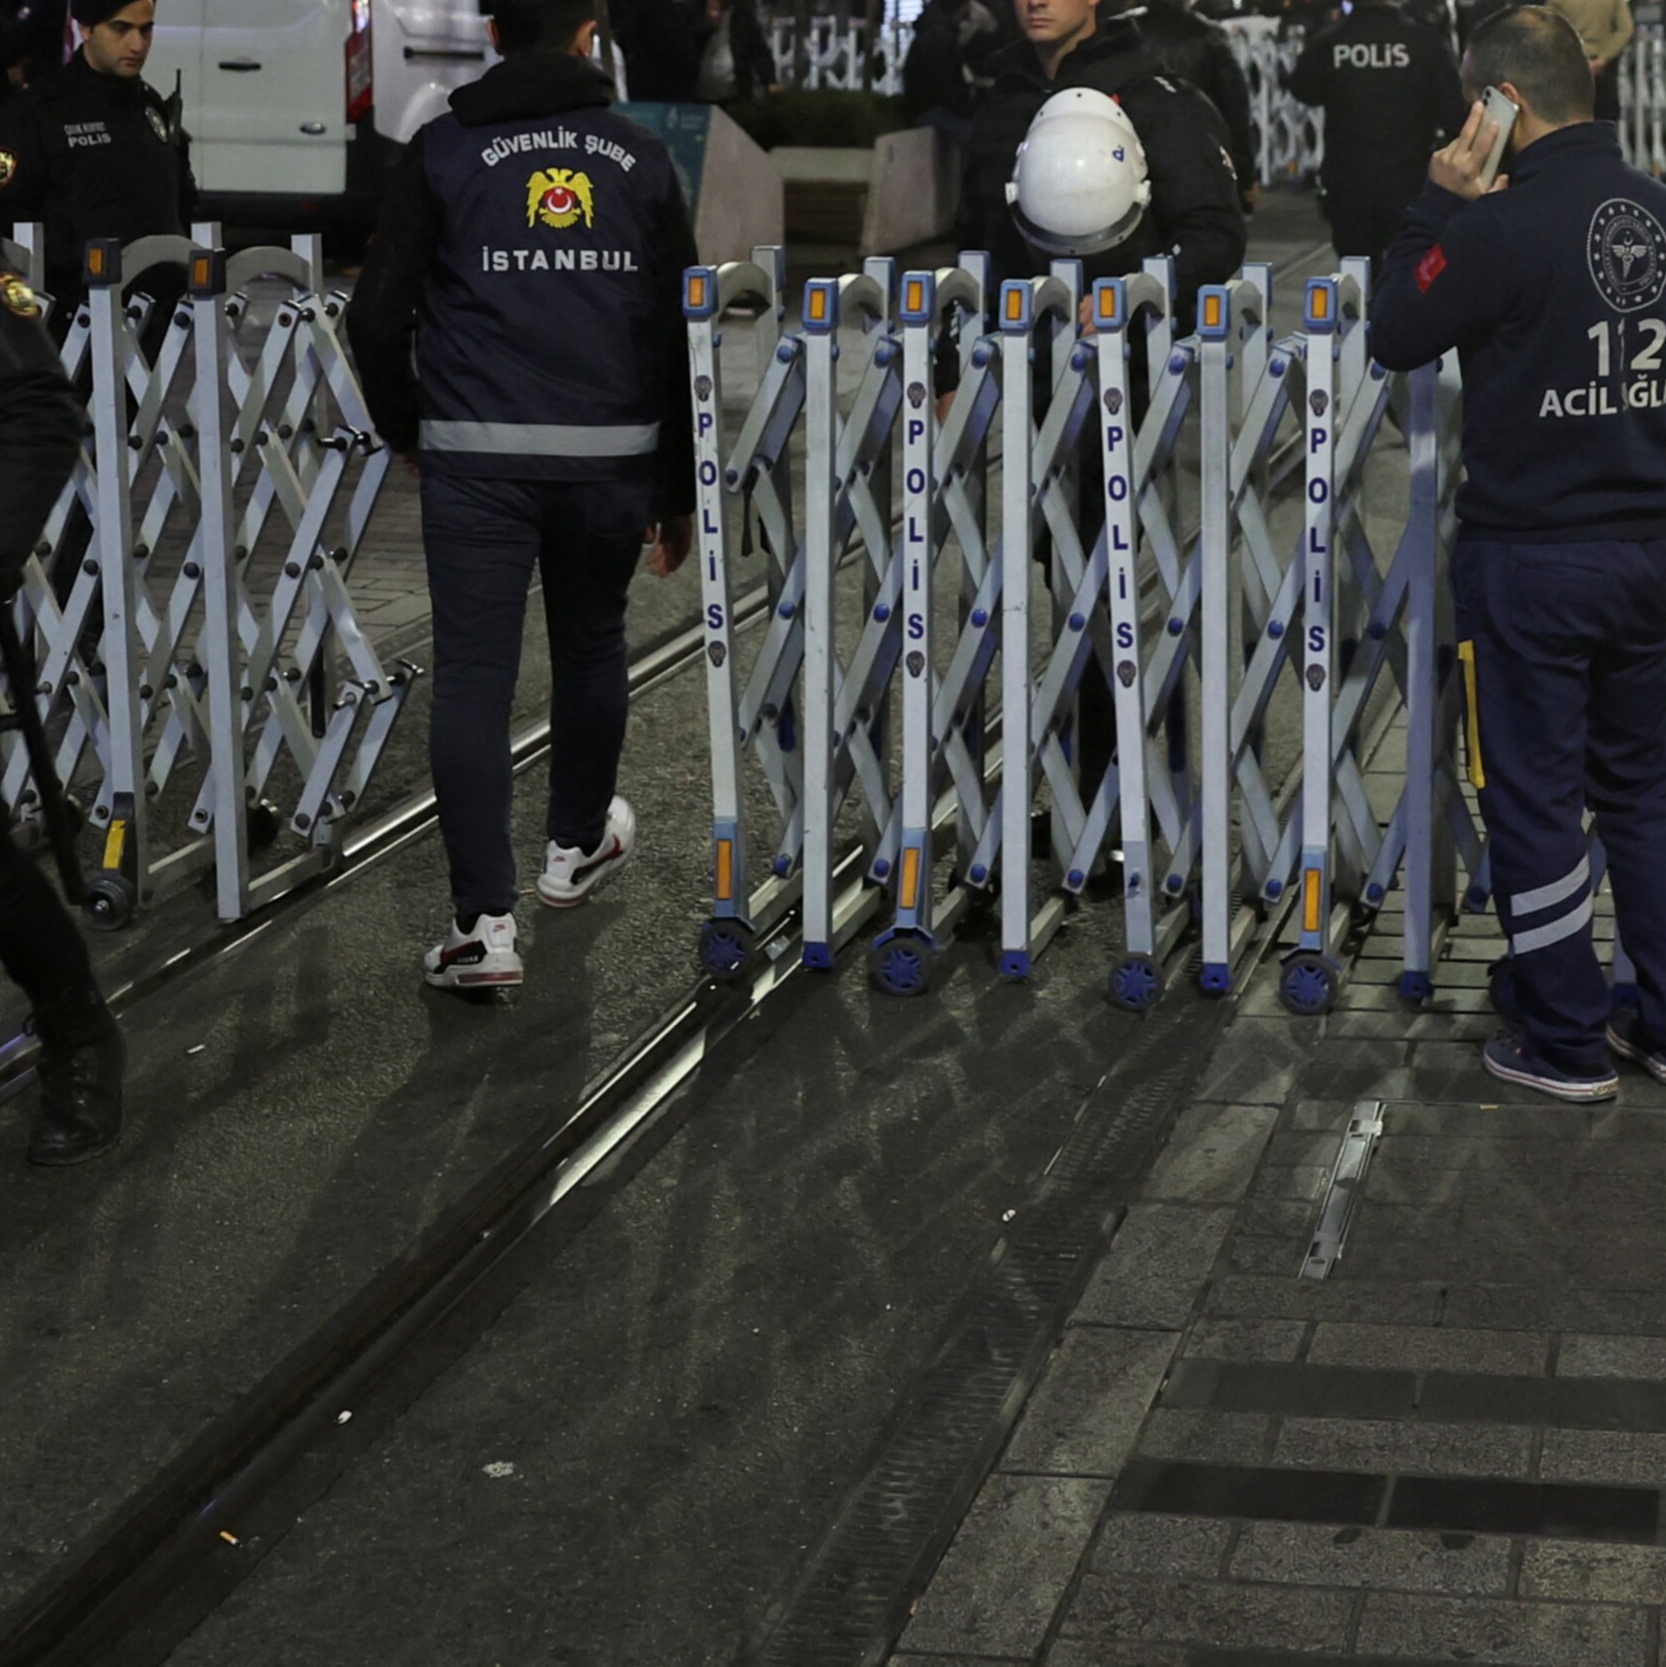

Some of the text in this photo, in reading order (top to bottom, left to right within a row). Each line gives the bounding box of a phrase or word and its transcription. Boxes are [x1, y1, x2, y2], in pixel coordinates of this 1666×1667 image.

[1333, 42, 1410, 70] POLİS
[480, 125, 638, 173] GÜVENLİK ŞUBE
[481, 245, 640, 273] İSTANBUL
[1538, 379, 1619, 418] ACİL
[697, 412, 724, 631] POLİS
[907, 419, 926, 641] POLİS
[1107, 425, 1135, 651] POLİS
[1308, 426, 1329, 654] POLİS
